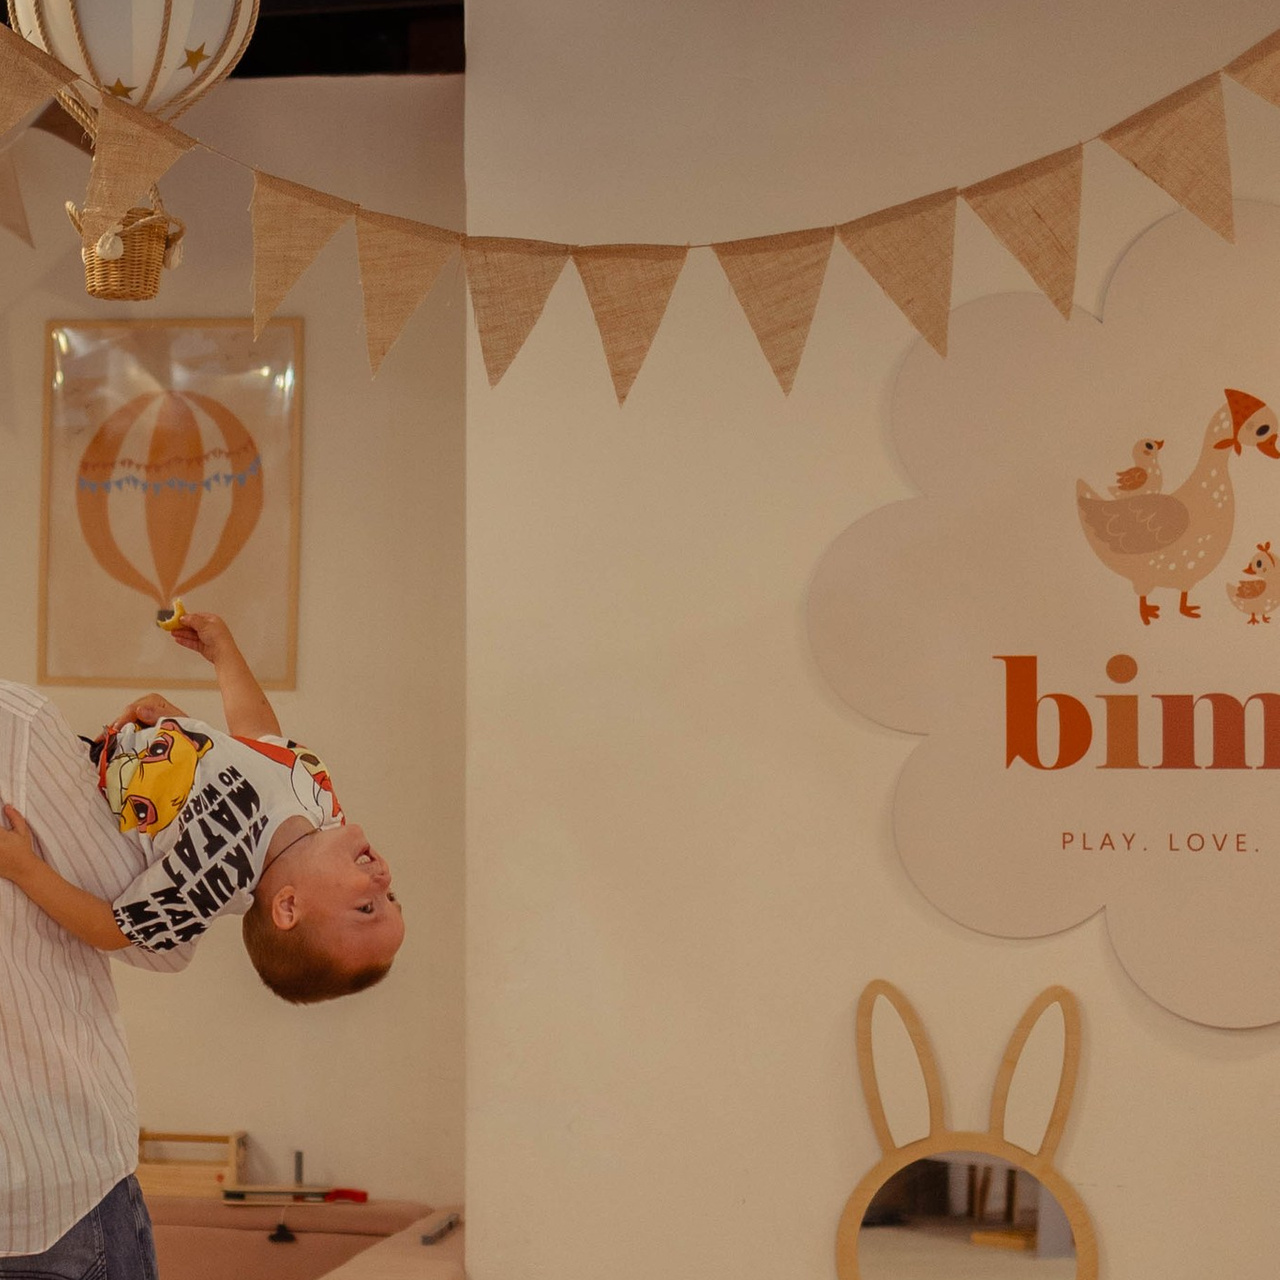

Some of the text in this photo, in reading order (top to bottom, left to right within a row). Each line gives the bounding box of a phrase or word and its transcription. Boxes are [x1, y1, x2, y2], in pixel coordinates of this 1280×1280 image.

[992, 654, 1280, 771] bim
[218, 765, 243, 787] NO
[1061, 832, 1260, 852] PLAY. LOVE.
